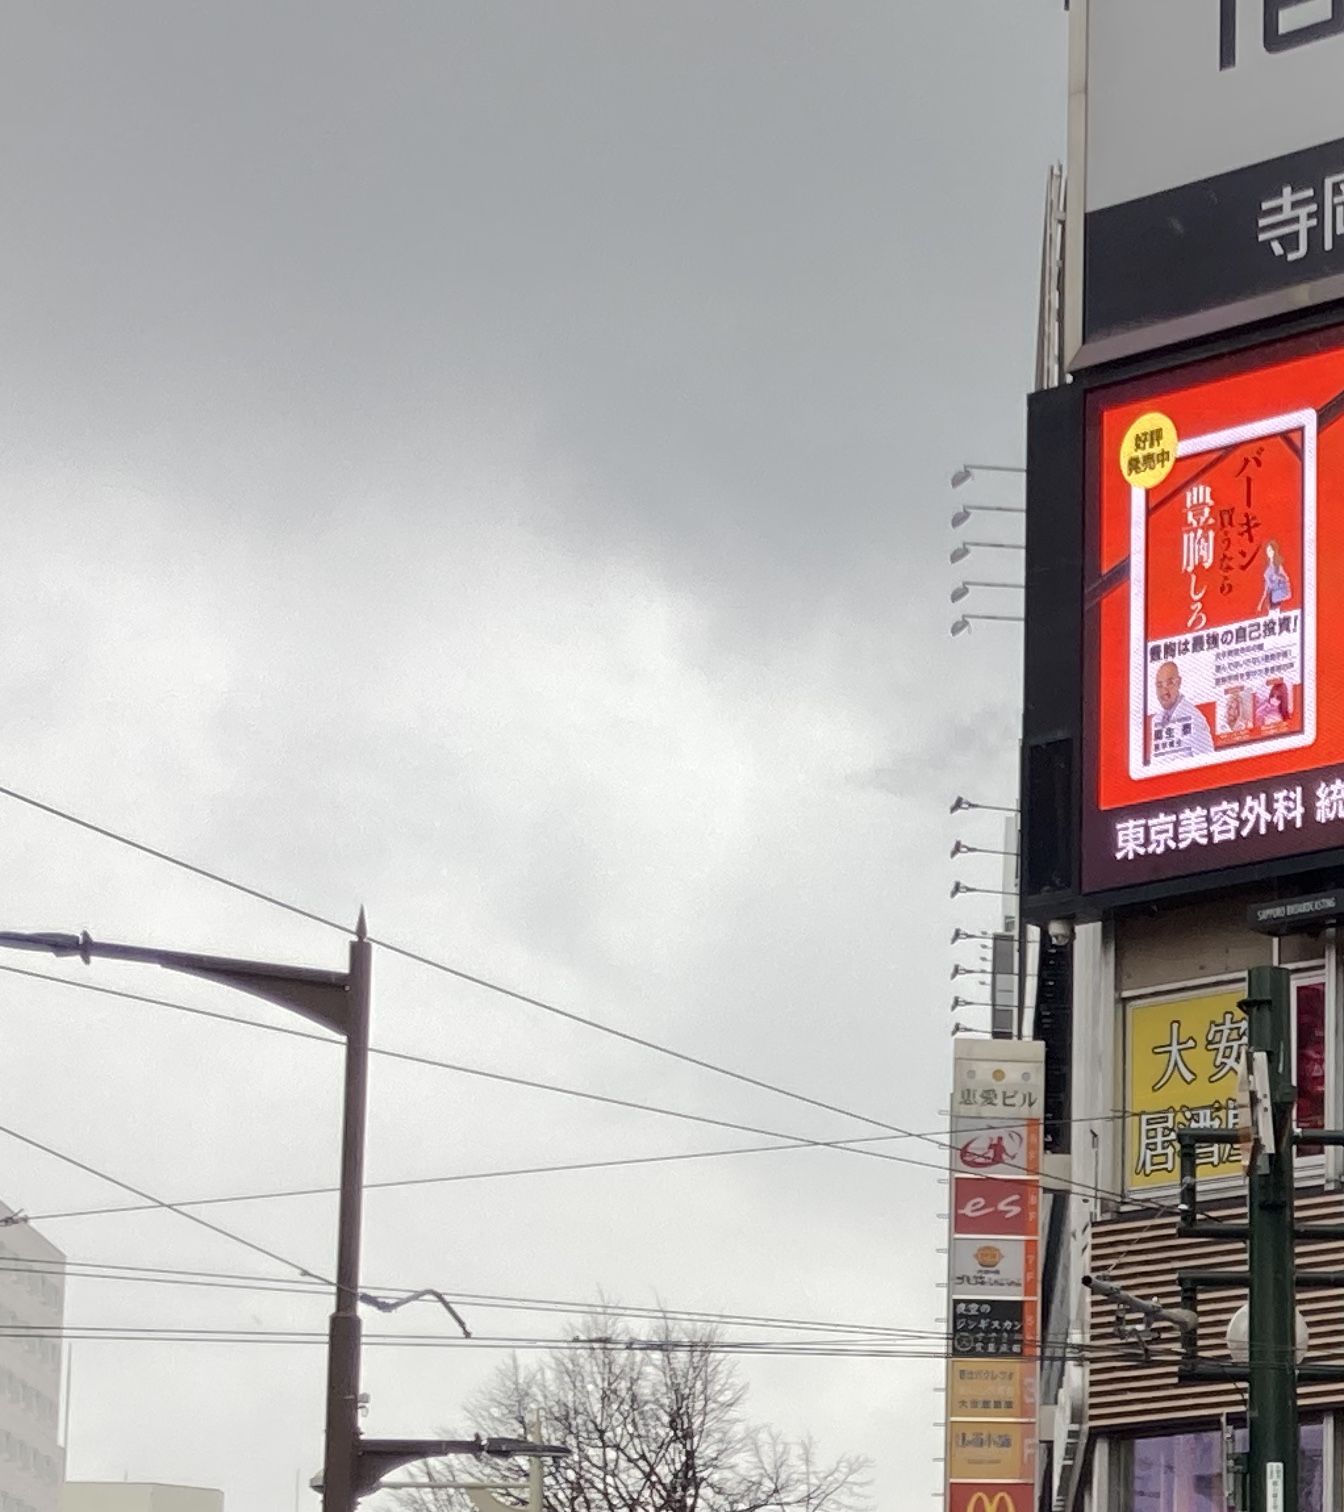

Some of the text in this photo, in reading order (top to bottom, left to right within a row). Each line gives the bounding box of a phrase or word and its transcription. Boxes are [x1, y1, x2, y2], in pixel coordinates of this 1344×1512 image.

[1181, 484, 1215, 630] 豊胸しろ
[1236, 447, 1265, 572] バーキン
[1114, 785, 1306, 862] 東京美容外科
[957, 1194, 1022, 1219] es
